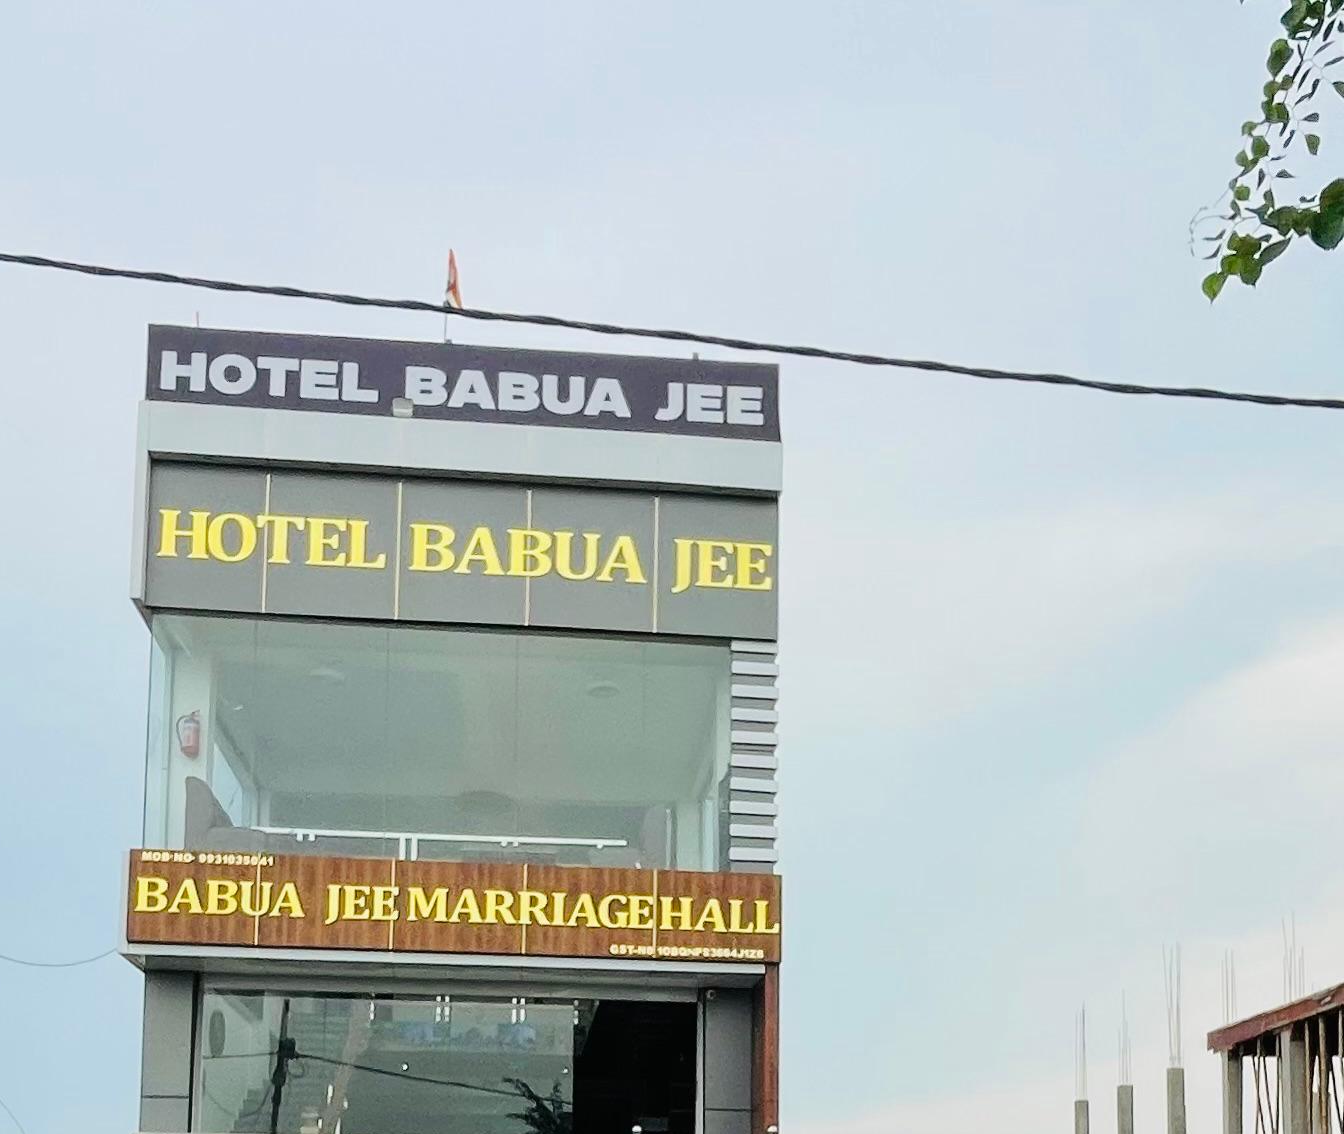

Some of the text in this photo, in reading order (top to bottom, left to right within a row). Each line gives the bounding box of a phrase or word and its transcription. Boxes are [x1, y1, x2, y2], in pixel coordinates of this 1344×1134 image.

[159, 350, 764, 425] HOTEL BABUA JEE
[156, 509, 773, 594] HOTEL BABUA JEE
[134, 876, 305, 919] BABUA
[325, 884, 399, 926] JEE
